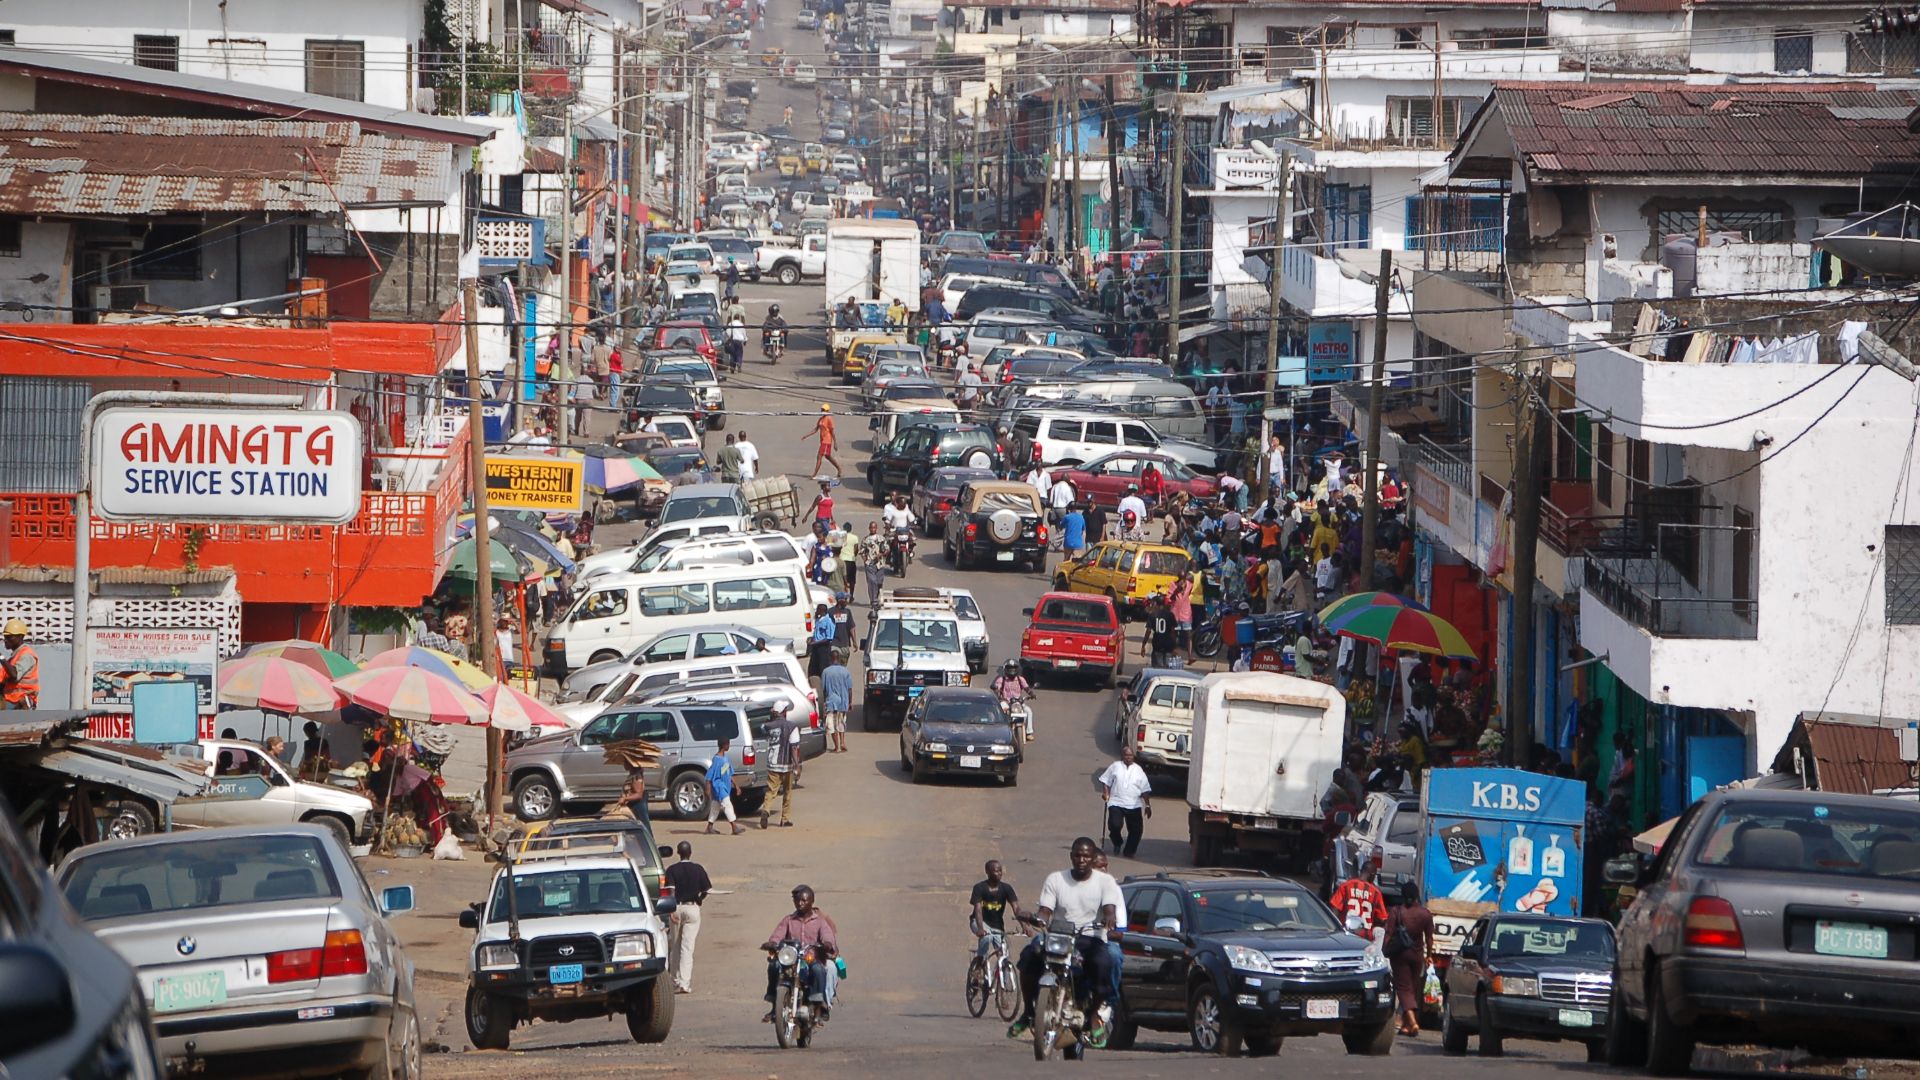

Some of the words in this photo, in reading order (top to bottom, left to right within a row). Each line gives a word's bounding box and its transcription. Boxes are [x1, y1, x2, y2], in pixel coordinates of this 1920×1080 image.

[1312, 342, 1349, 354] METRO
[120, 422, 334, 466] AMINATA
[487, 464, 561, 479] WESTERN
[124, 468, 222, 495] SERVICE
[230, 470, 328, 496] STATION
[510, 478, 561, 491] UNION
[521, 493, 572, 504] TRANSFER
[1155, 617, 1166, 633] 10
[96, 632, 121, 640] BRAND
[123, 632, 139, 640] NEW
[173, 633, 189, 641] FOR
[191, 633, 212, 641] SALE
[1253, 663, 1280, 671] PARKING
[88, 714, 133, 739] HOUSE
[1471, 781, 1541, 812] K.B.S
